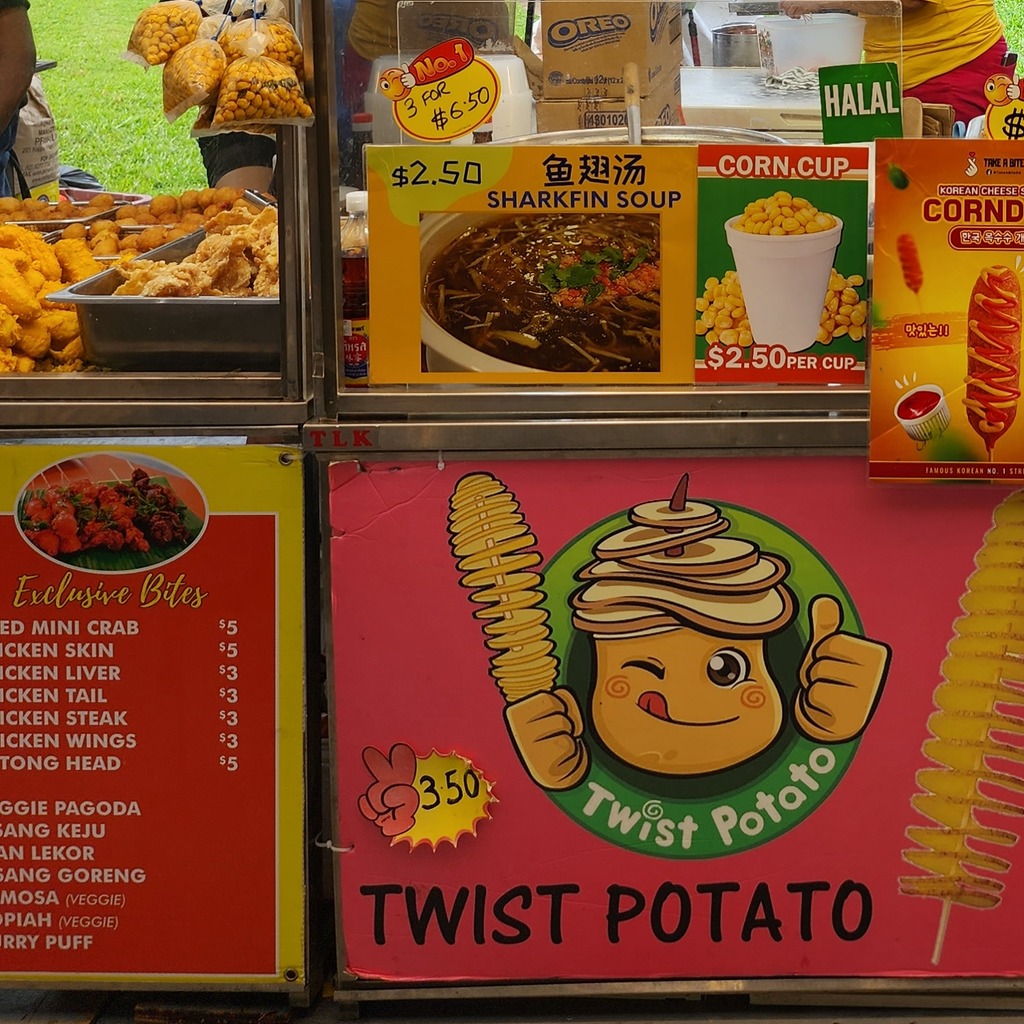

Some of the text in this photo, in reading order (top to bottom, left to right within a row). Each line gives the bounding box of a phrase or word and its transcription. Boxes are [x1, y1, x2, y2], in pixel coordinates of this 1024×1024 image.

[548, 14, 631, 48] OREO
[414, 43, 468, 82] No. 1
[404, 81, 451, 118] 3 FOR
[824, 81, 899, 117] HALAL
[542, 153, 645, 186] 鱼翅汤
[718, 155, 849, 176] CORN CUP
[984, 158, 1024, 167] TAKE BITE
[392, 160, 481, 187] $2.50
[940, 187, 978, 195] KOREAN
[981, 187, 1017, 195] CHEESE
[488, 190, 681, 208] SHARKFIN SOUP
[962, 232, 980, 243] 한국
[708, 345, 854, 370] $2.50 PER CUP
[310, 430, 372, 448] TLK
[13, 571, 208, 609] Exclusive Bites
[32, 621, 139, 635] MINI CRAB
[65, 642, 238, 657] SKIN $5
[66, 665, 238, 681] LIVER $3
[66, 688, 238, 703] TAIL $3
[66, 711, 238, 726] STEAK $3
[66, 733, 238, 749] WINGS $3
[66, 756, 238, 771] HEAD $5
[55, 801, 141, 815] PAGODA
[57, 824, 105, 838] KEJU
[32, 846, 95, 860] LEKOR
[58, 869, 146, 883] GORENG
[66, 894, 125, 908] (VEGGIE)
[359, 880, 874, 946] TWIST POTATO
[59, 916, 118, 930] (VEGGIE)
[46, 935, 93, 949] PUFF
